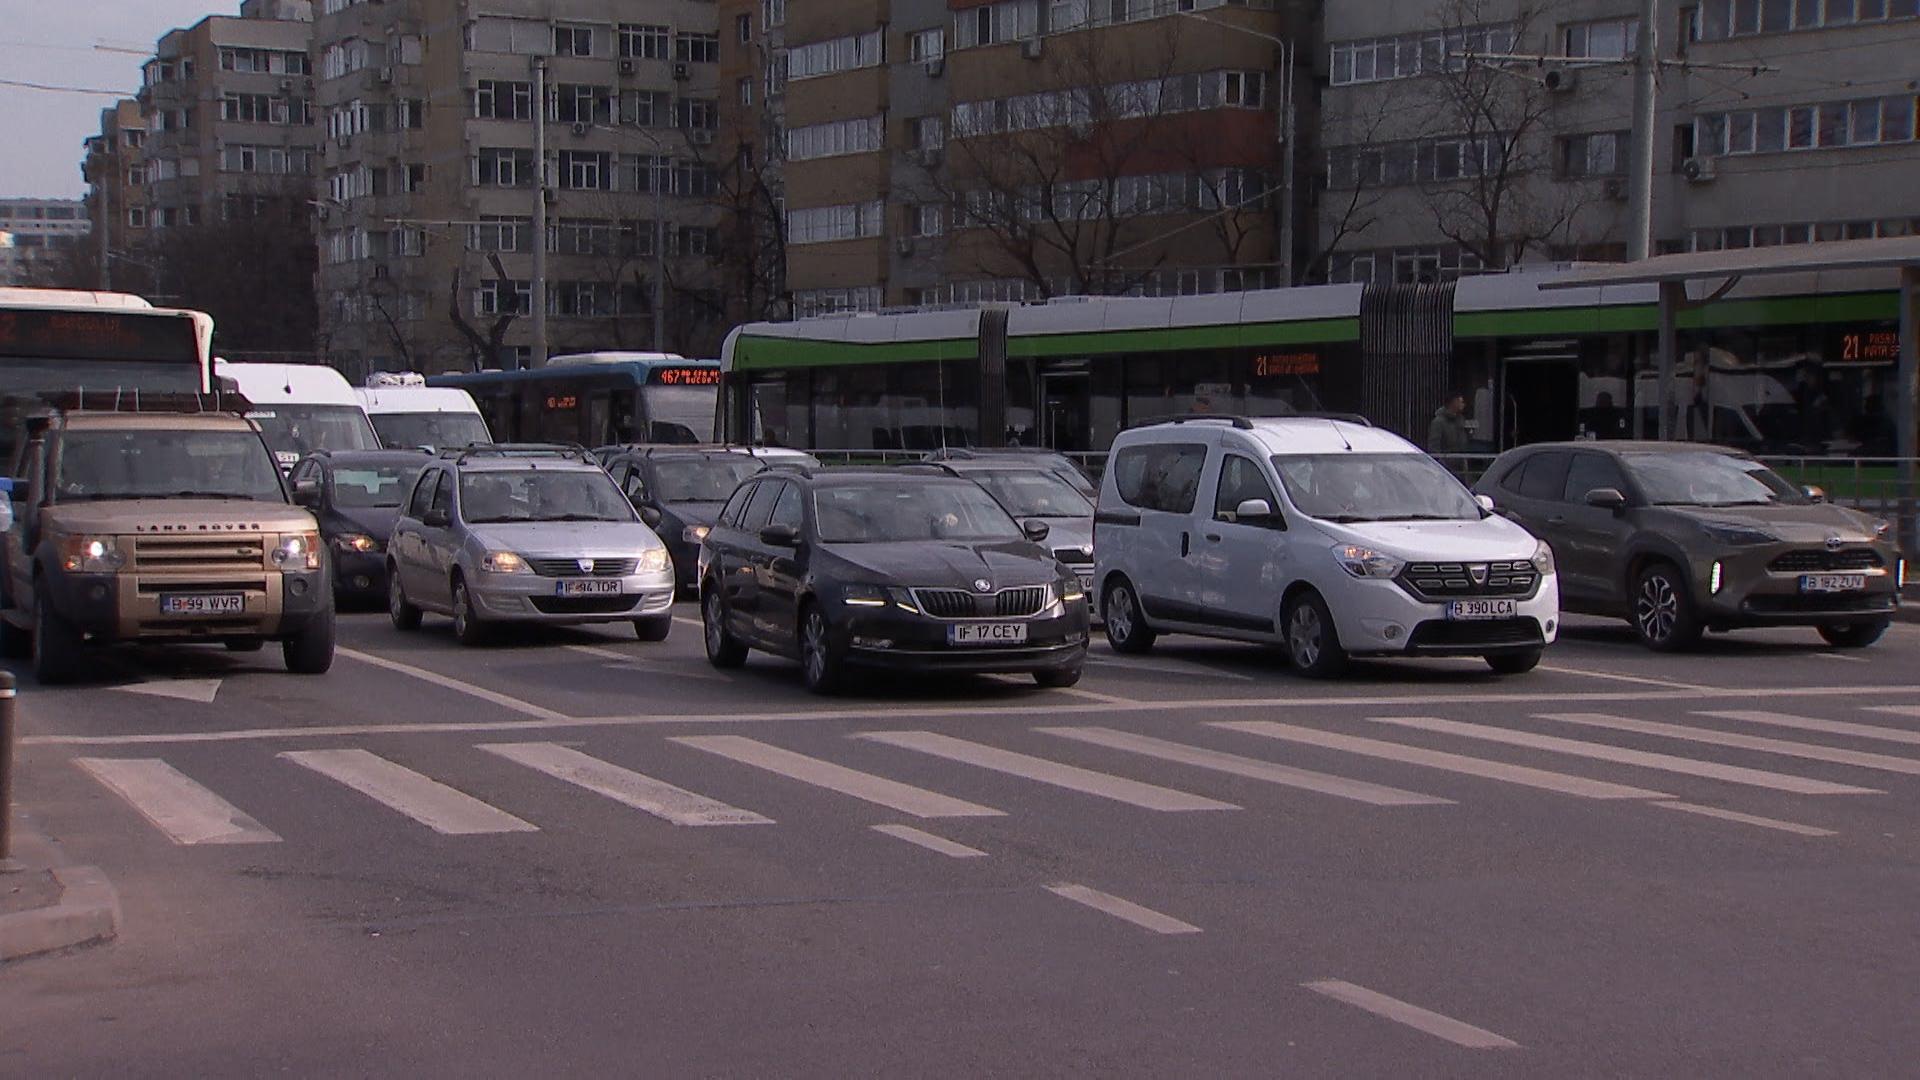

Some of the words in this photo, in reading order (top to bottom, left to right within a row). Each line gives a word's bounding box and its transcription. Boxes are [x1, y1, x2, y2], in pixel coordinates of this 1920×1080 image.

[1843, 335, 1859, 359] 21
[1256, 355, 1267, 376] 21
[661, 369, 680, 384] 467
[198, 523, 260, 531] ROVER
[564, 581, 575, 593] IF
[1808, 577, 1817, 588] B
[171, 598, 182, 610] B
[187, 597, 203, 610] 99
[210, 596, 240, 609] WVR
[1454, 602, 1463, 614] B
[1467, 601, 1488, 614] 390
[1490, 601, 1512, 614] LCA
[959, 626, 970, 639] IF
[977, 625, 989, 638] 17
[993, 625, 1021, 638] CEY
